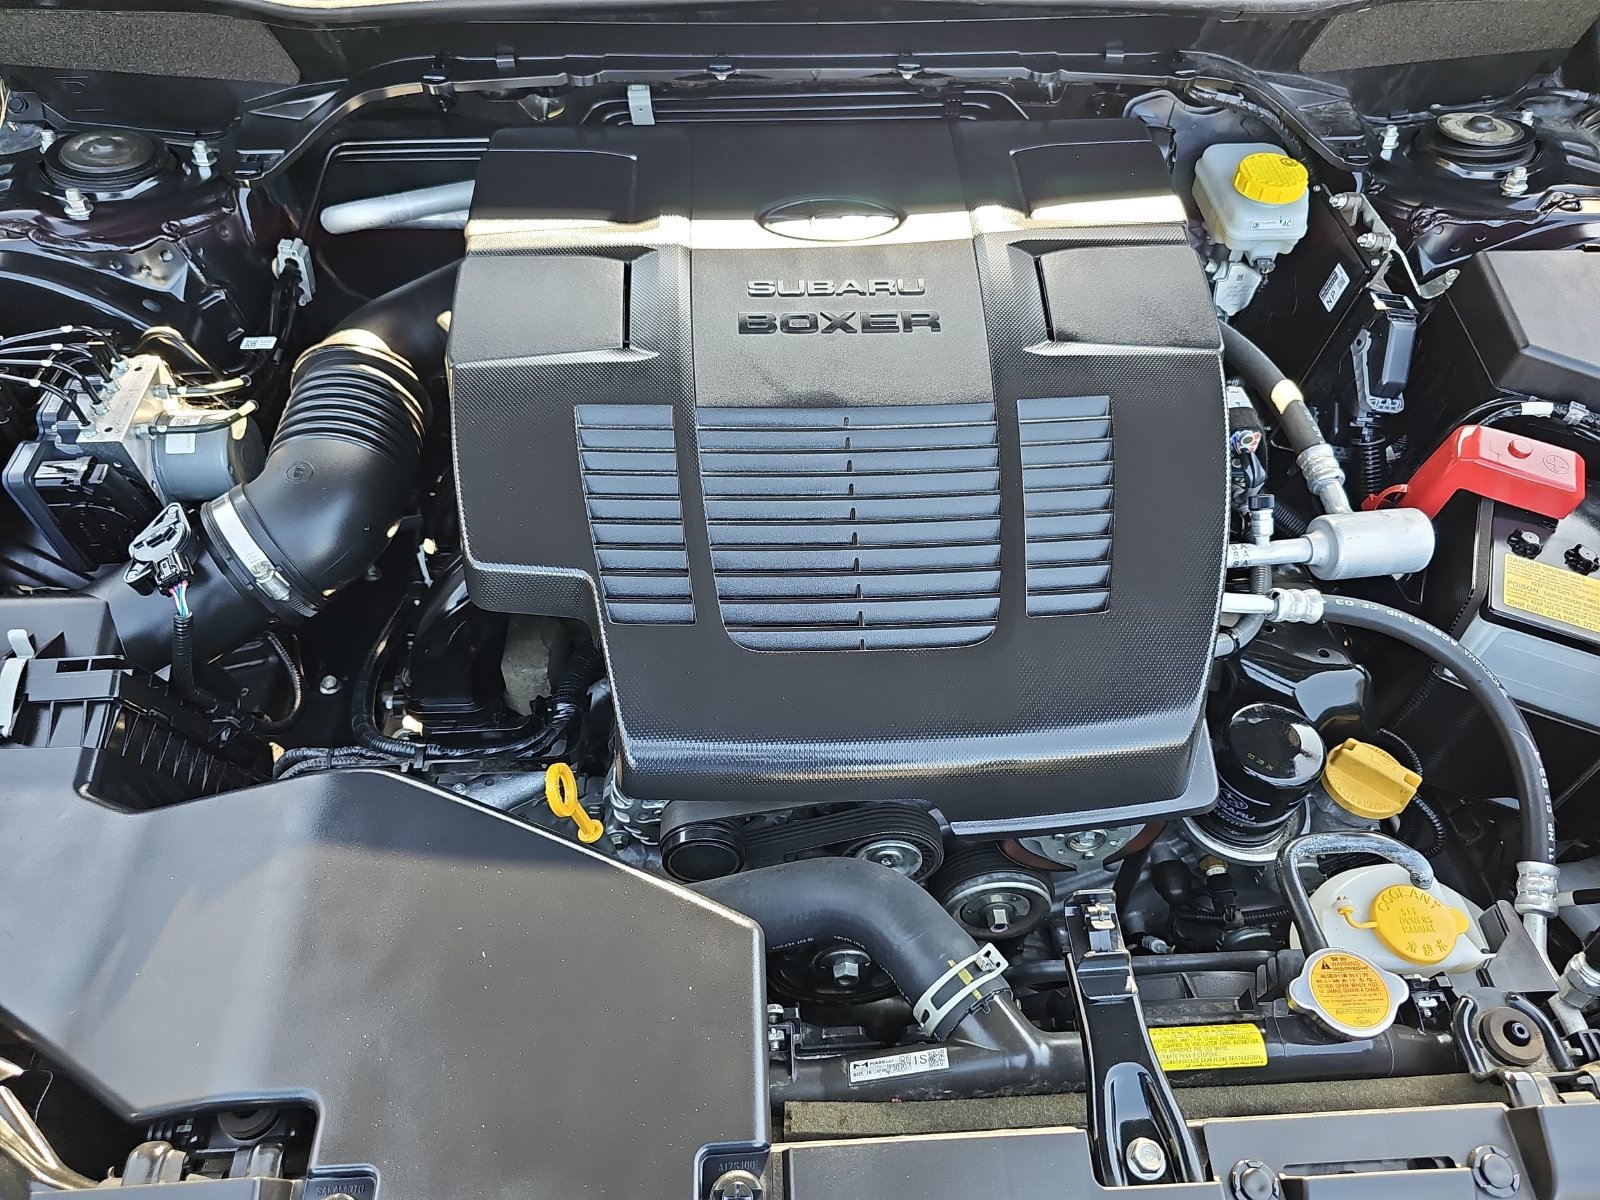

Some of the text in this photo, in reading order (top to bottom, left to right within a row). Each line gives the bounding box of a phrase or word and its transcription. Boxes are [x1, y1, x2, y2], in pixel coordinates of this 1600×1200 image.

[748, 279, 925, 297] SUBARU
[738, 311, 941, 334] BOXER
[1508, 556, 1540, 569] DANGER
[1507, 580, 1538, 592] POISON
[1386, 609, 1402, 618] HP
[1464, 648, 1501, 687] YOKOHAMA
[1378, 888, 1441, 912] COOLANT
[1400, 907, 1416, 916] SEE
[1402, 924, 1436, 934] MANUAL
[316, 1184, 366, 1195] SAKAMOTO
